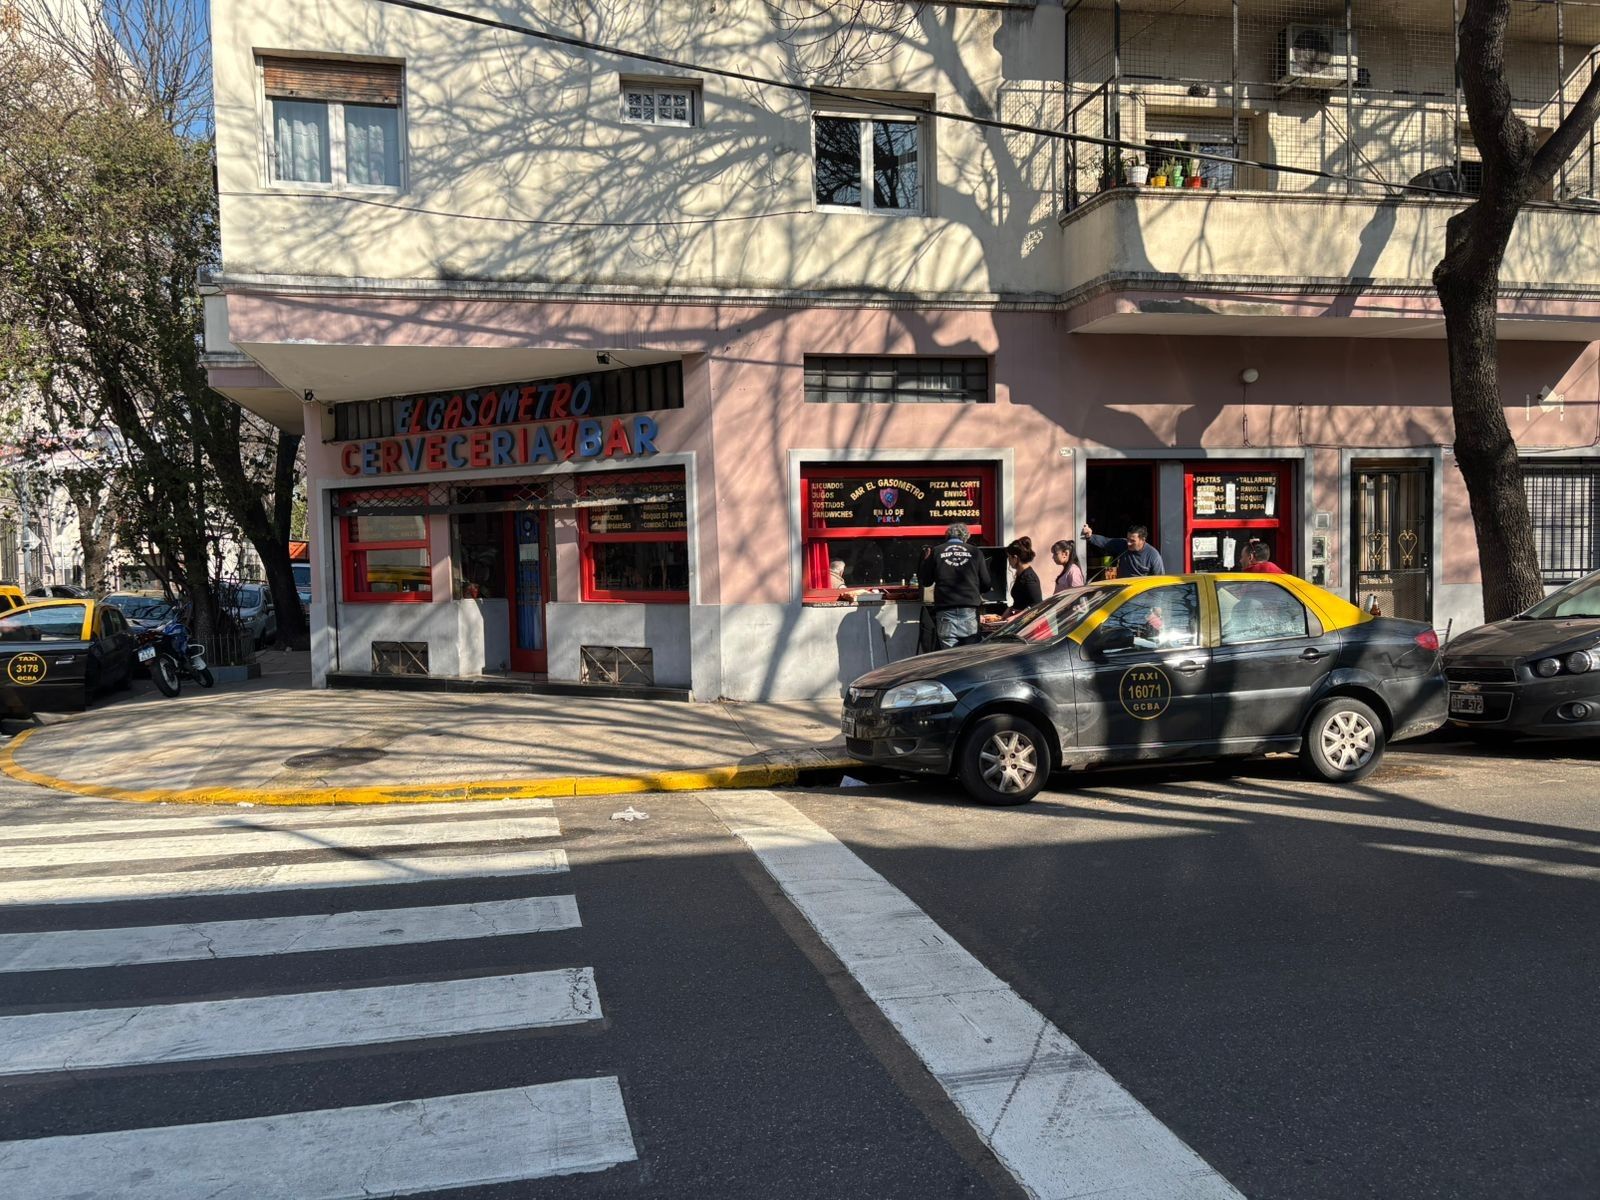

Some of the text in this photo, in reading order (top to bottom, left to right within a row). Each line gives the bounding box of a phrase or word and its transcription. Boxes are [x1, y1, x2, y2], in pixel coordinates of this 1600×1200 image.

[395, 380, 591, 435] EL GASOMETRO
[341, 425, 556, 475] CERVECERIA
[579, 415, 660, 457] BAR
[850, 478, 925, 500] BAR EL GASOMETRO
[929, 481, 949, 489] PIZZA
[944, 490, 967, 498] ENVIOS
[812, 501, 845, 509] TOSTADOS
[812, 510, 853, 518] SANDWICHES
[16, 664, 39, 673] 3178
[1130, 672, 1158, 680] TAXI
[1128, 684, 1161, 699] 16071
[1132, 702, 1160, 711] GCBA
